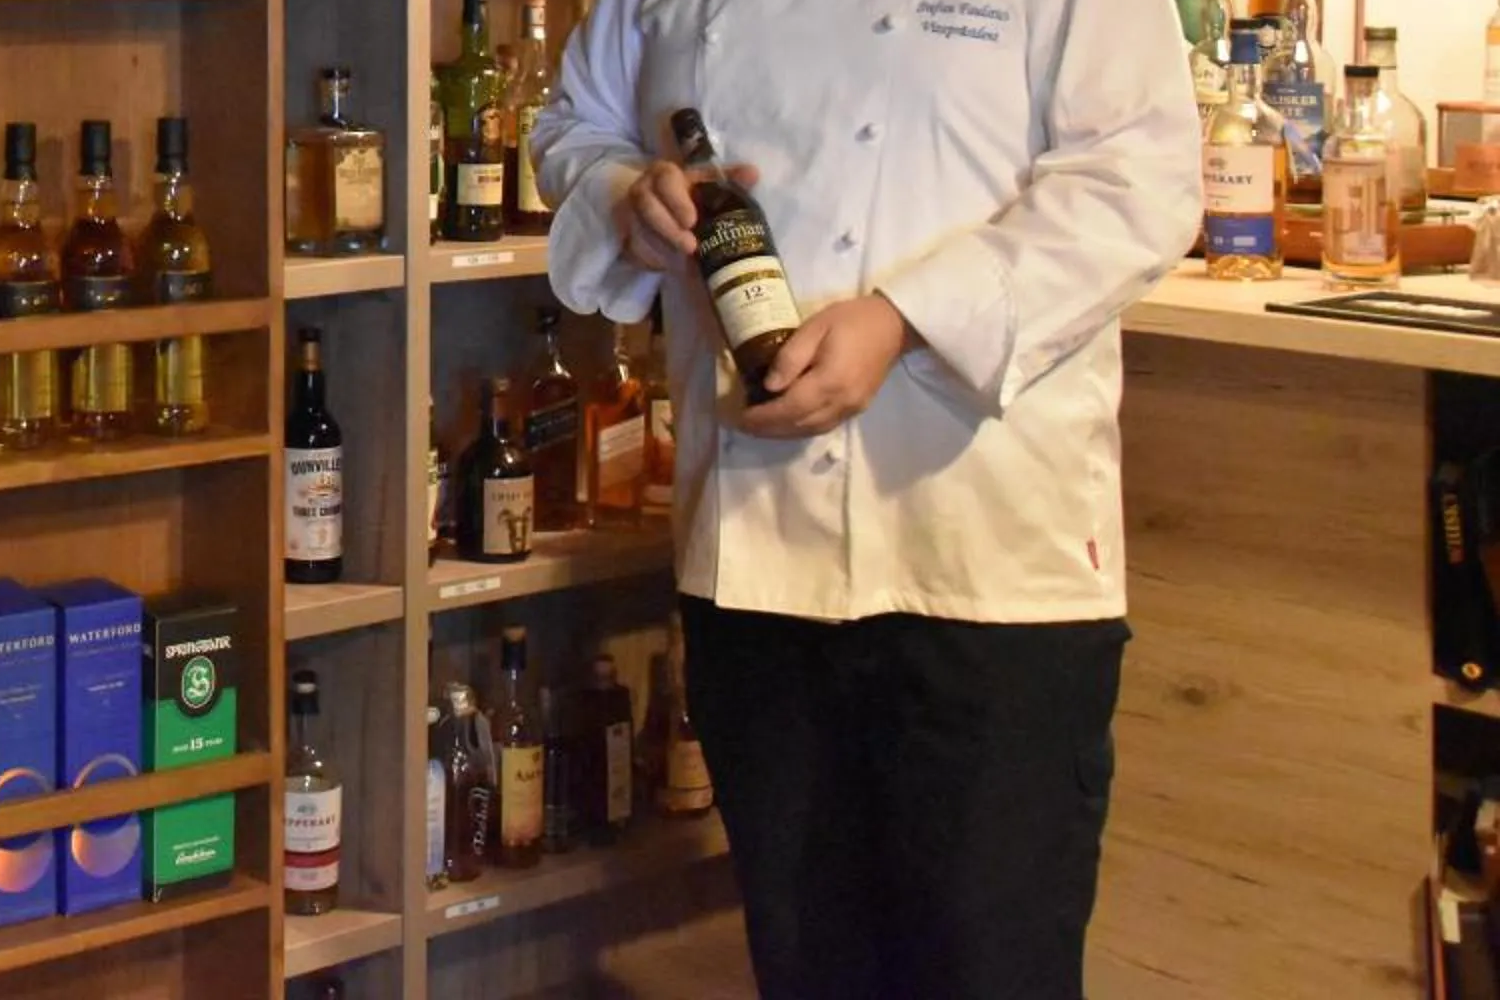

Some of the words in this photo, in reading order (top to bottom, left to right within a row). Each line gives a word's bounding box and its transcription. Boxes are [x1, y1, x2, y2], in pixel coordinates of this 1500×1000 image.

[743, 284, 765, 301] 12
[68, 622, 142, 645] WATERFORD
[165, 635, 232, 660] SPRINGBANK
[189, 736, 204, 752] 15
